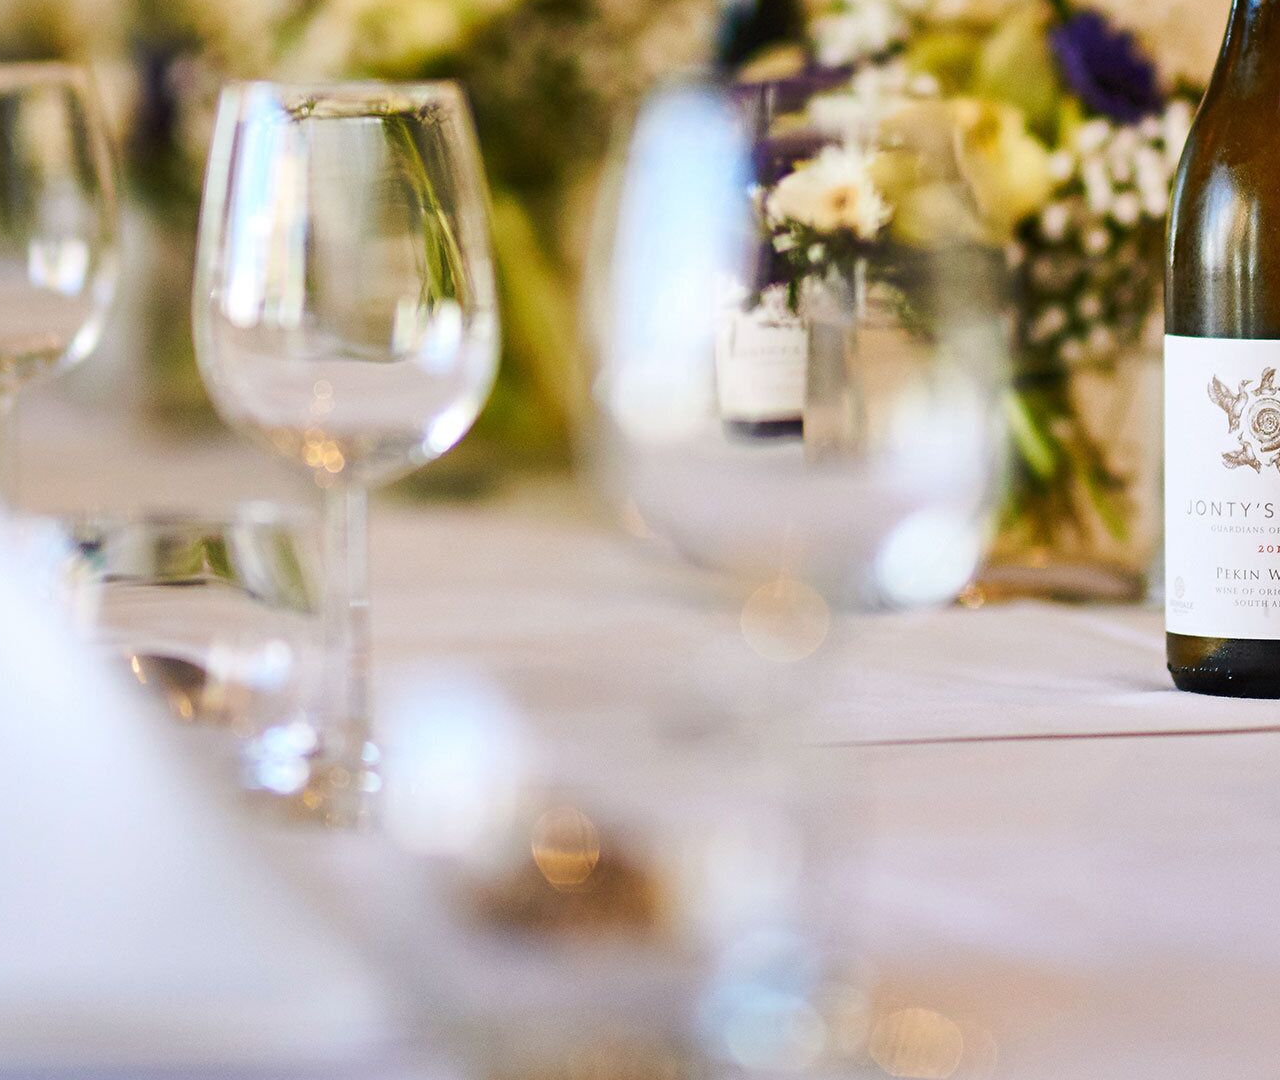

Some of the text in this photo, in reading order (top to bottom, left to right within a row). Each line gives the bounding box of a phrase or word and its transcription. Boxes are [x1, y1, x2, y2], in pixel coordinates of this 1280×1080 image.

[1186, 500, 1274, 519] JONTY'S
[1211, 525, 1265, 535] GUARDIANS
[1214, 586, 1238, 596] WINE
[1241, 587, 1254, 596] OF
[1233, 599, 1268, 608] SOUTH
